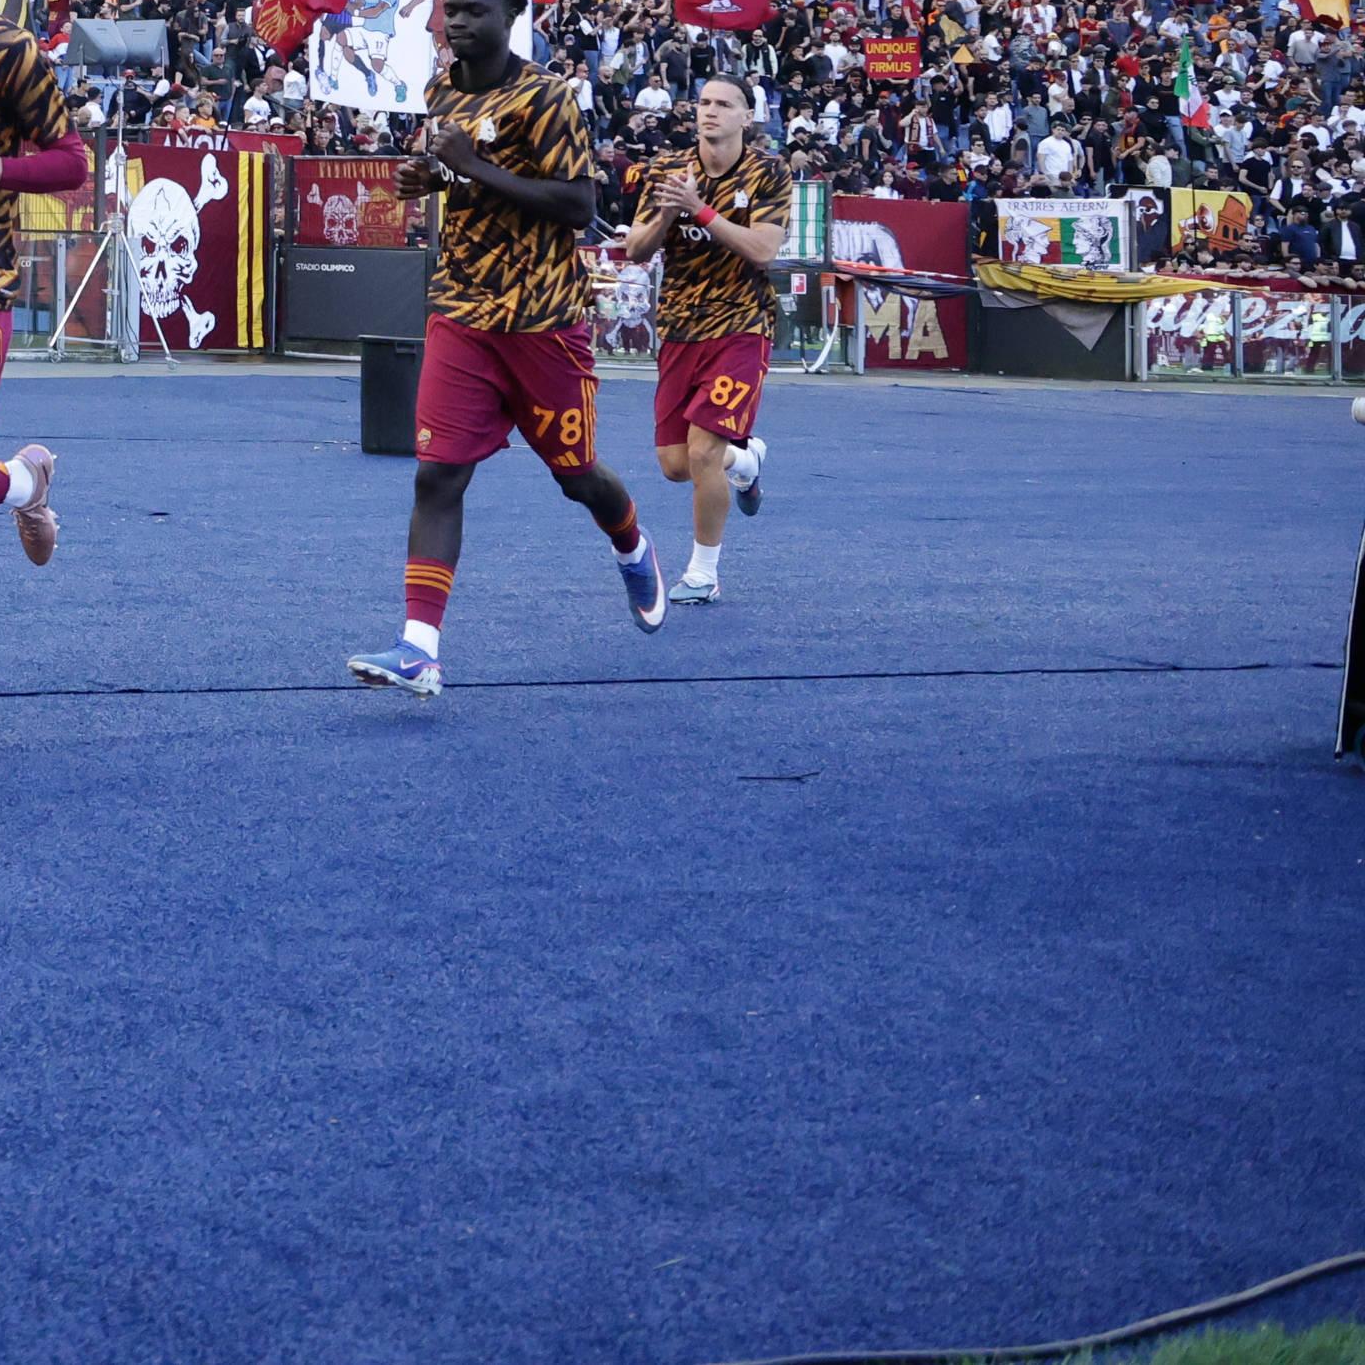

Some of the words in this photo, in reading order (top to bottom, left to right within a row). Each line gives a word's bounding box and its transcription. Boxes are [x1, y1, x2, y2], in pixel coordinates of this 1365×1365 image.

[866, 42, 918, 55] UNDIQUE
[869, 61, 912, 74] FIRMUS
[296, 263, 320, 272] STADIO
[320, 263, 355, 273] OLIMPICO
[709, 375, 751, 410] 87
[532, 405, 582, 446] 78
